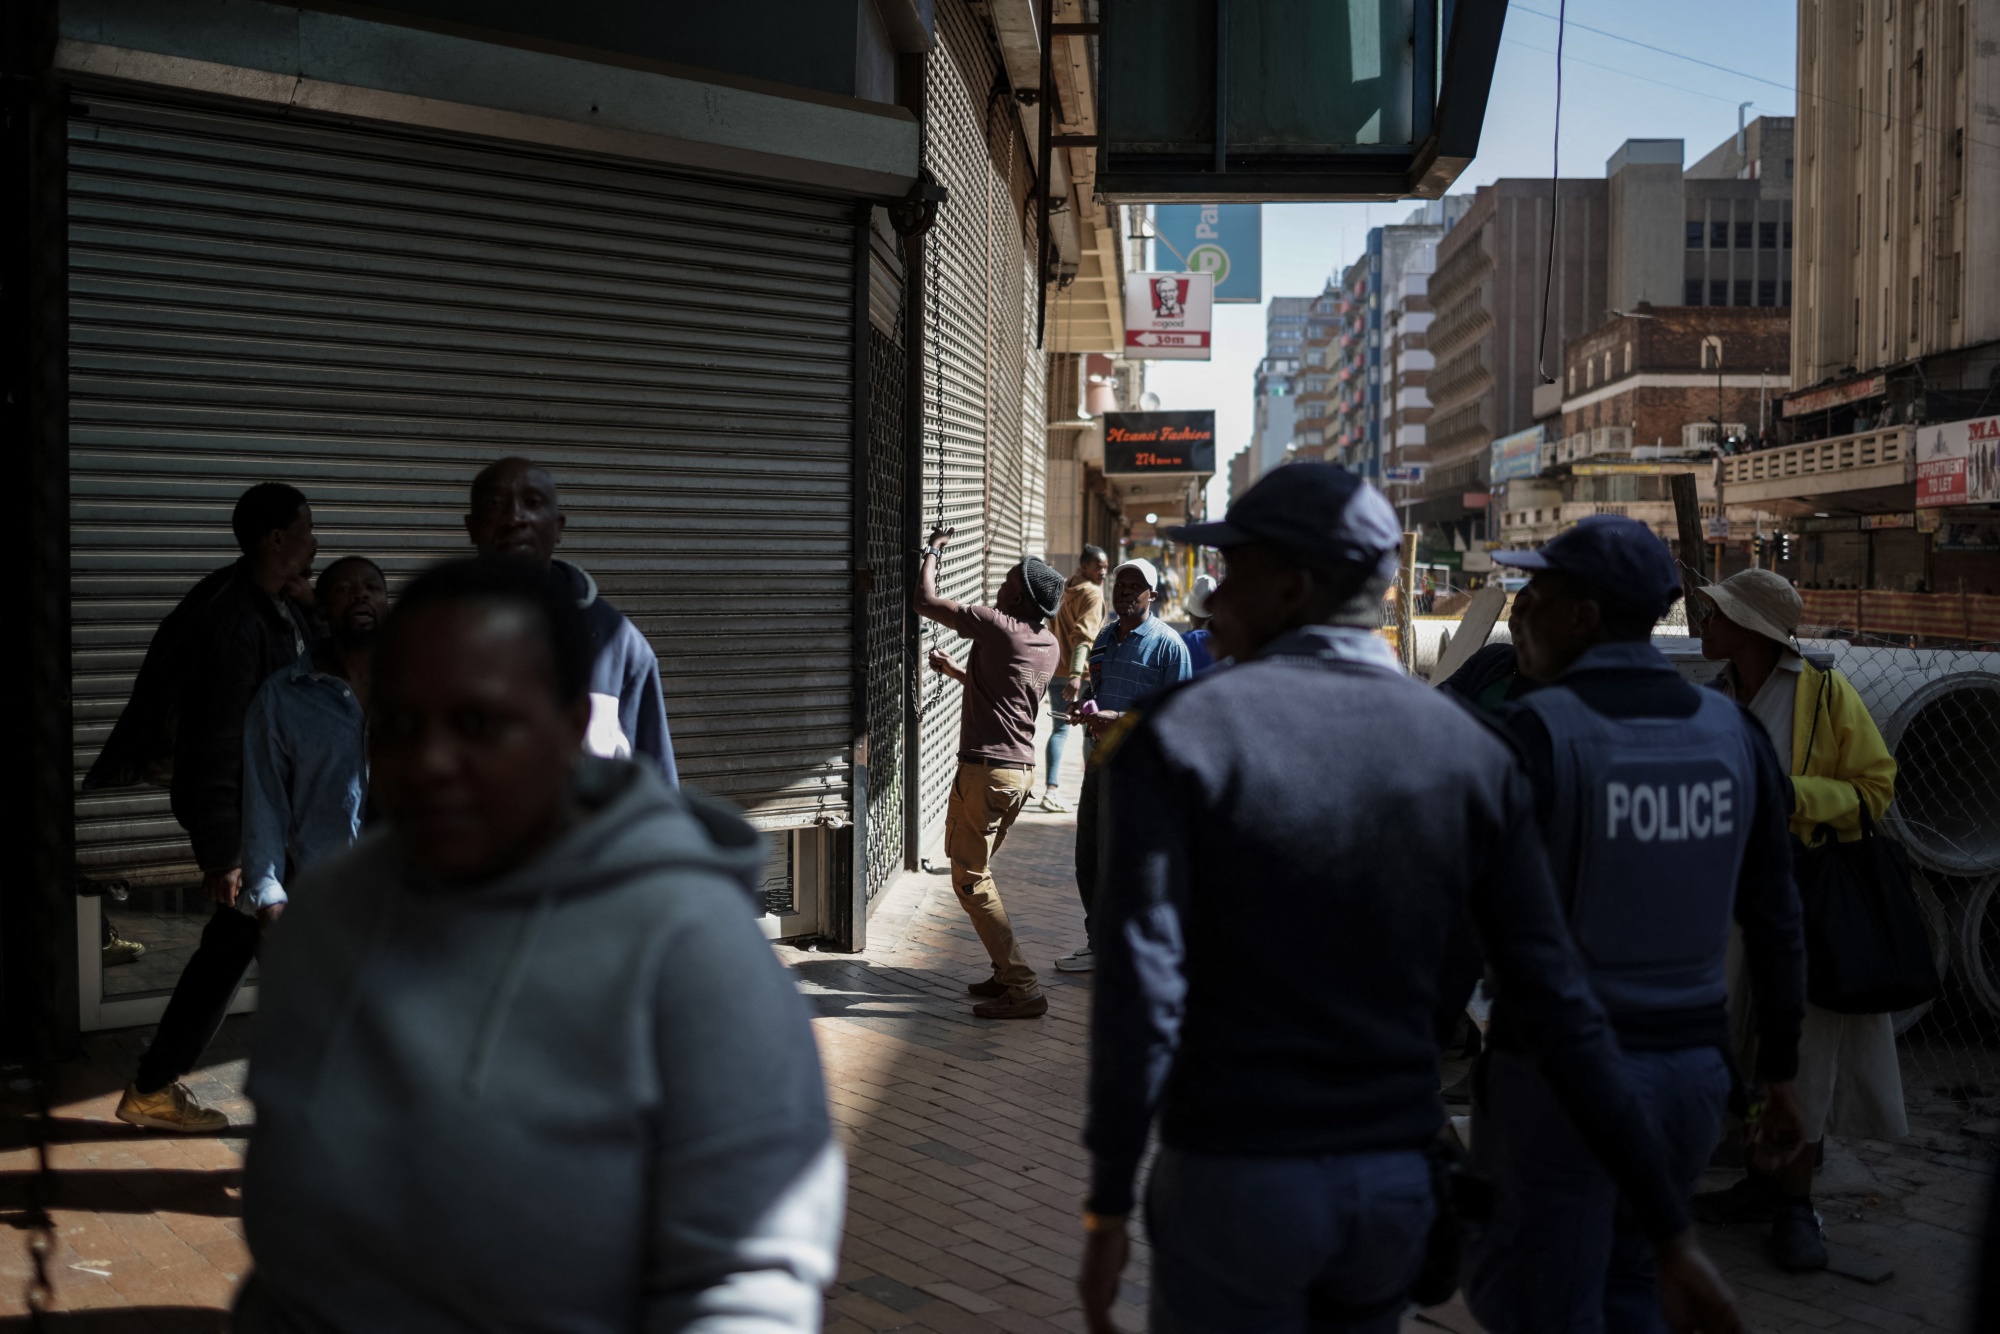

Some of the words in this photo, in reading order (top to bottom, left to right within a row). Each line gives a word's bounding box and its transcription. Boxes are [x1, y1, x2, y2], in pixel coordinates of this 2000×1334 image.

[1156, 335, 1185, 345] 30m
[1106, 427, 1157, 442] Mzansi
[1160, 426, 1211, 441] Fashion
[1135, 453, 1156, 465] 274
[1917, 459, 1965, 479] APPARTMENT
[1928, 479, 1938, 493] TO
[1939, 477, 1952, 492] LET
[1606, 778, 1733, 842] POLICE
